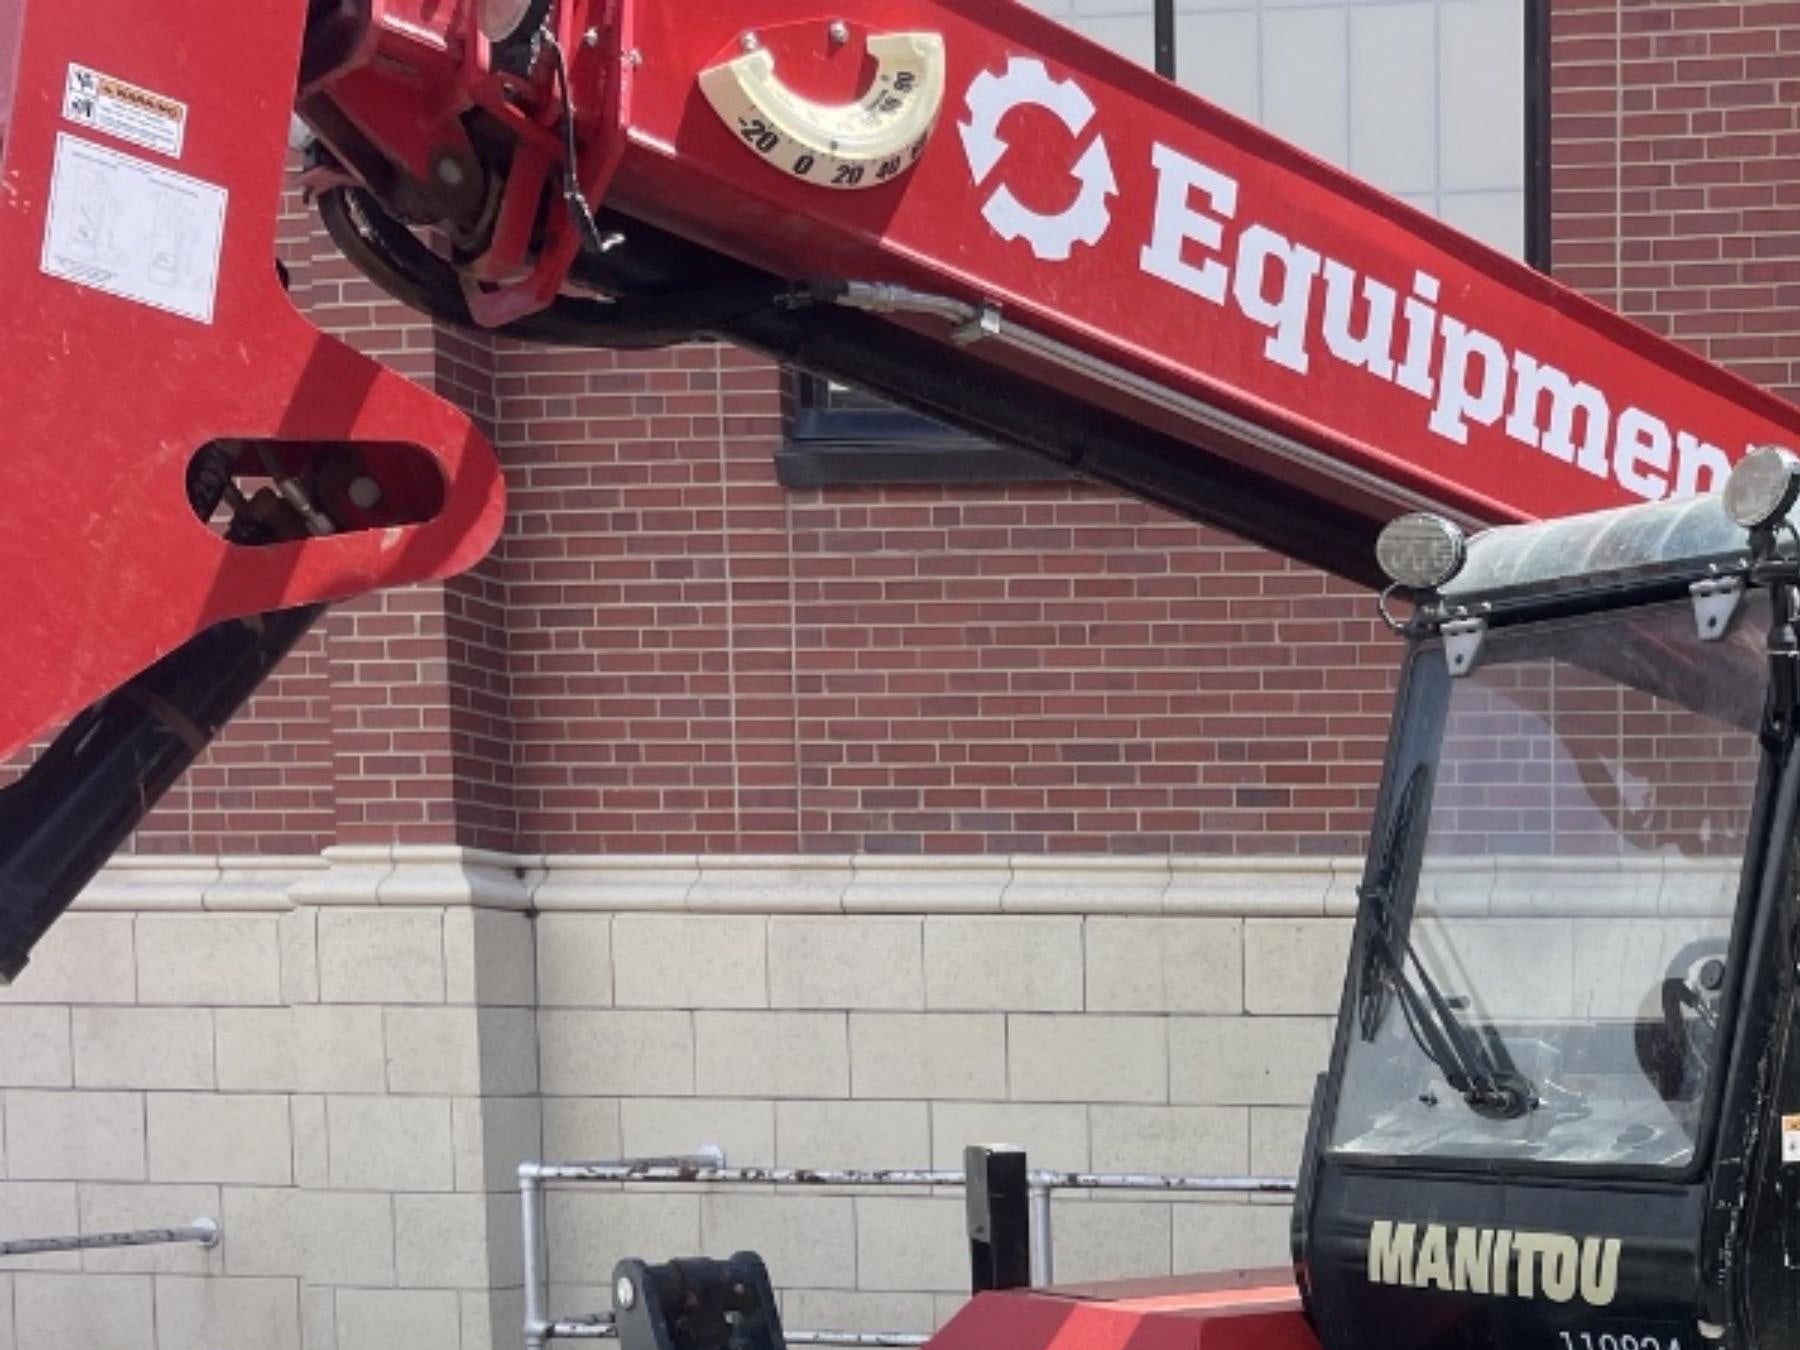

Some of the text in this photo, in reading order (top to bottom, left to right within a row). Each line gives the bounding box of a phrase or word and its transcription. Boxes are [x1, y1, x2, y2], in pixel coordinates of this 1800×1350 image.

[738, 115, 777, 153] -20
[793, 155, 813, 175] 0
[831, 163, 864, 185] 20
[1138, 142, 1757, 500] Equipmen
[1368, 1219, 1622, 1306] MANITOU
